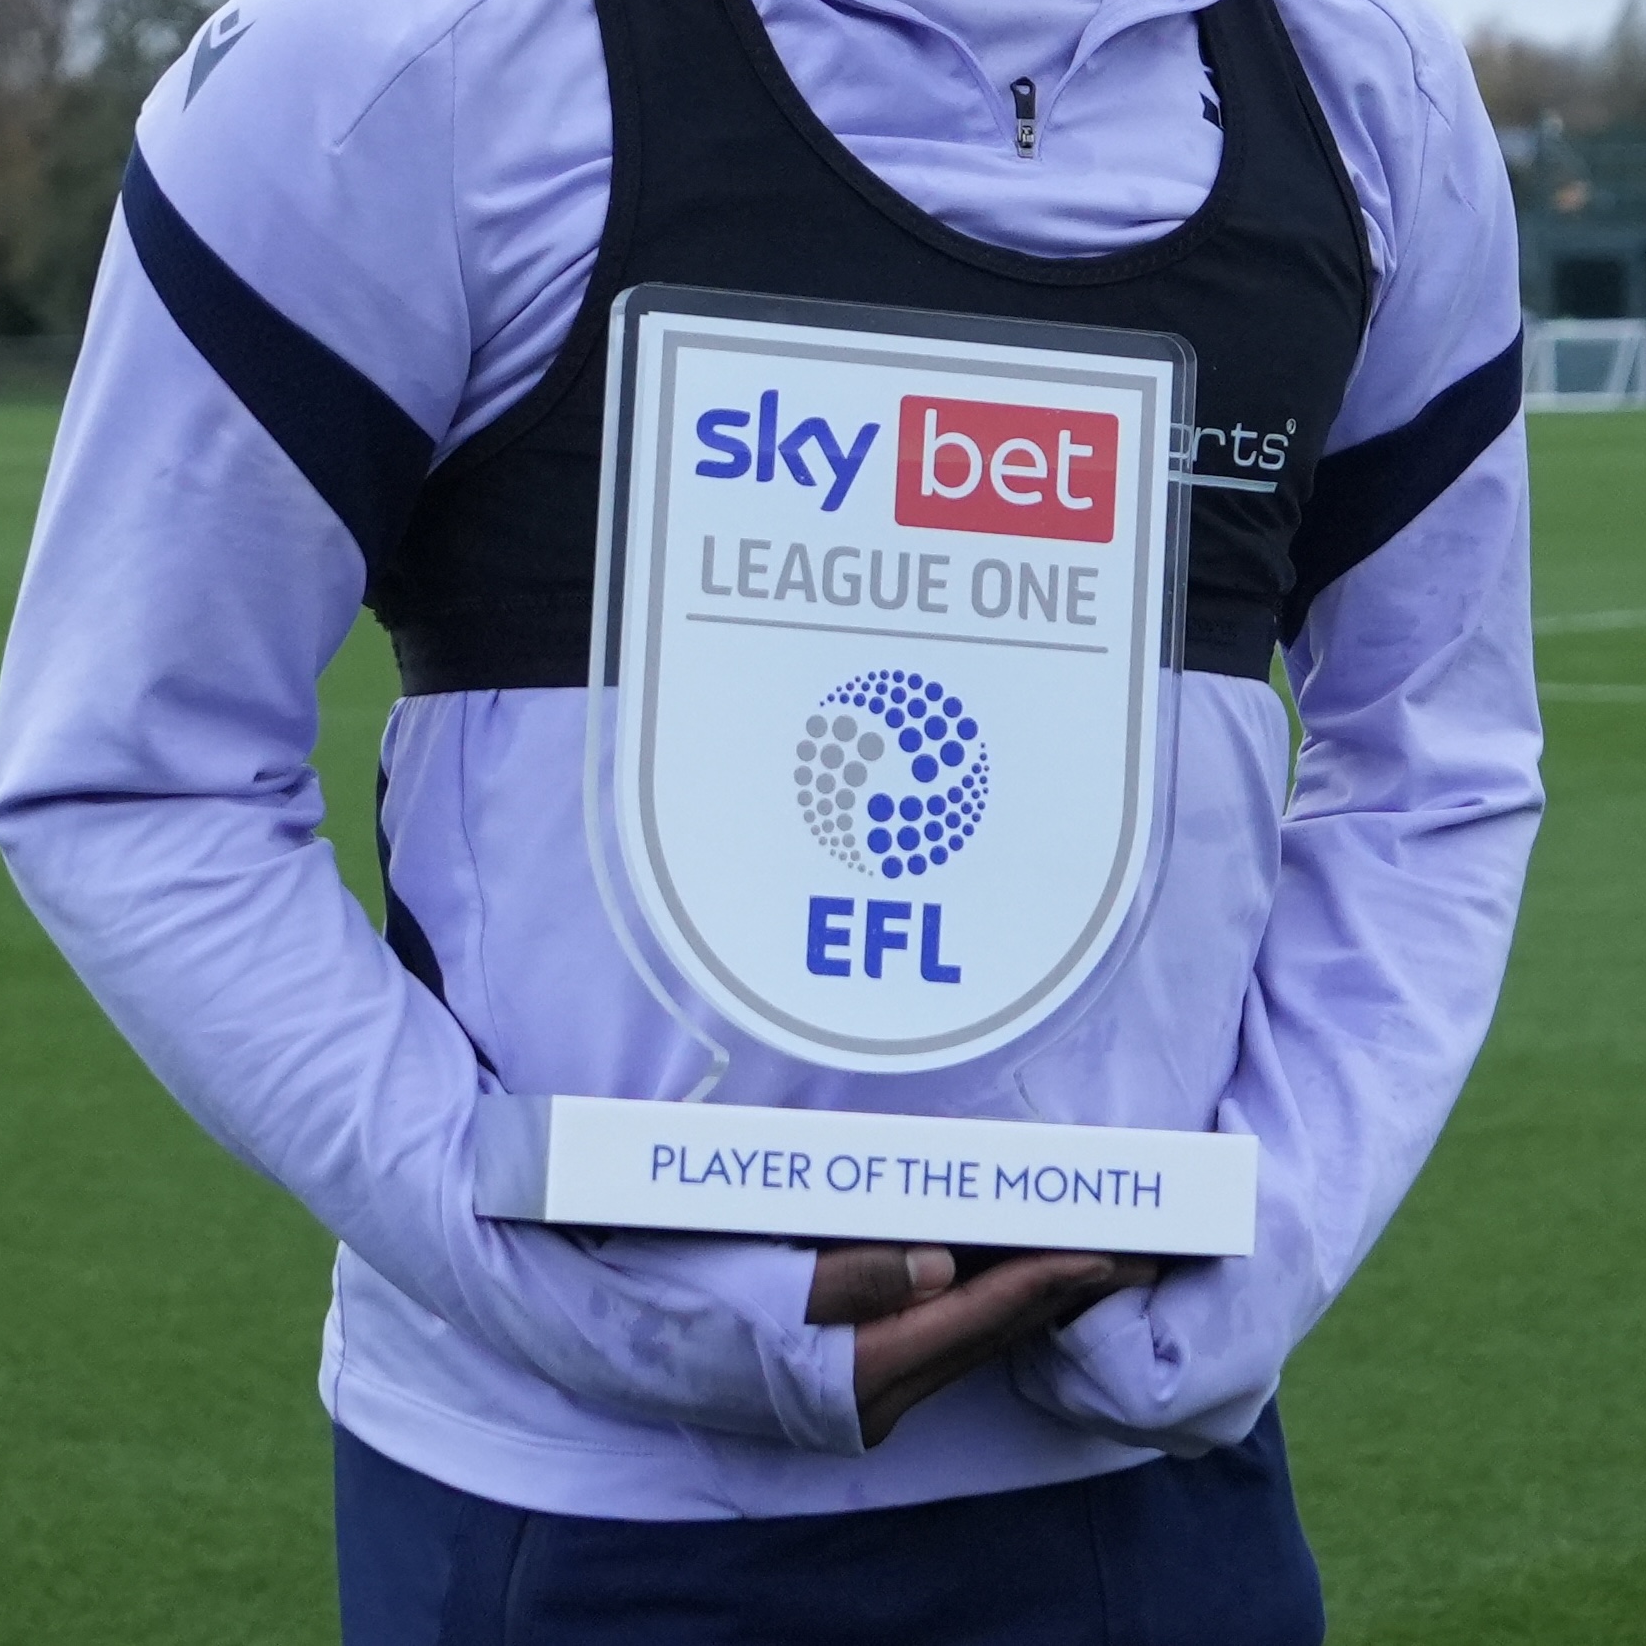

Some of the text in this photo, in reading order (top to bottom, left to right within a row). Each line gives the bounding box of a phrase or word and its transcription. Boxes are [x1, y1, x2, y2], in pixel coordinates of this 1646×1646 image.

[695, 389, 1094, 512] sky bet
[700, 535, 1101, 627] LEAGUE ONE
[806, 895, 963, 986] EFL
[651, 1144, 1164, 1209] PLAYER OF THE MONTH
